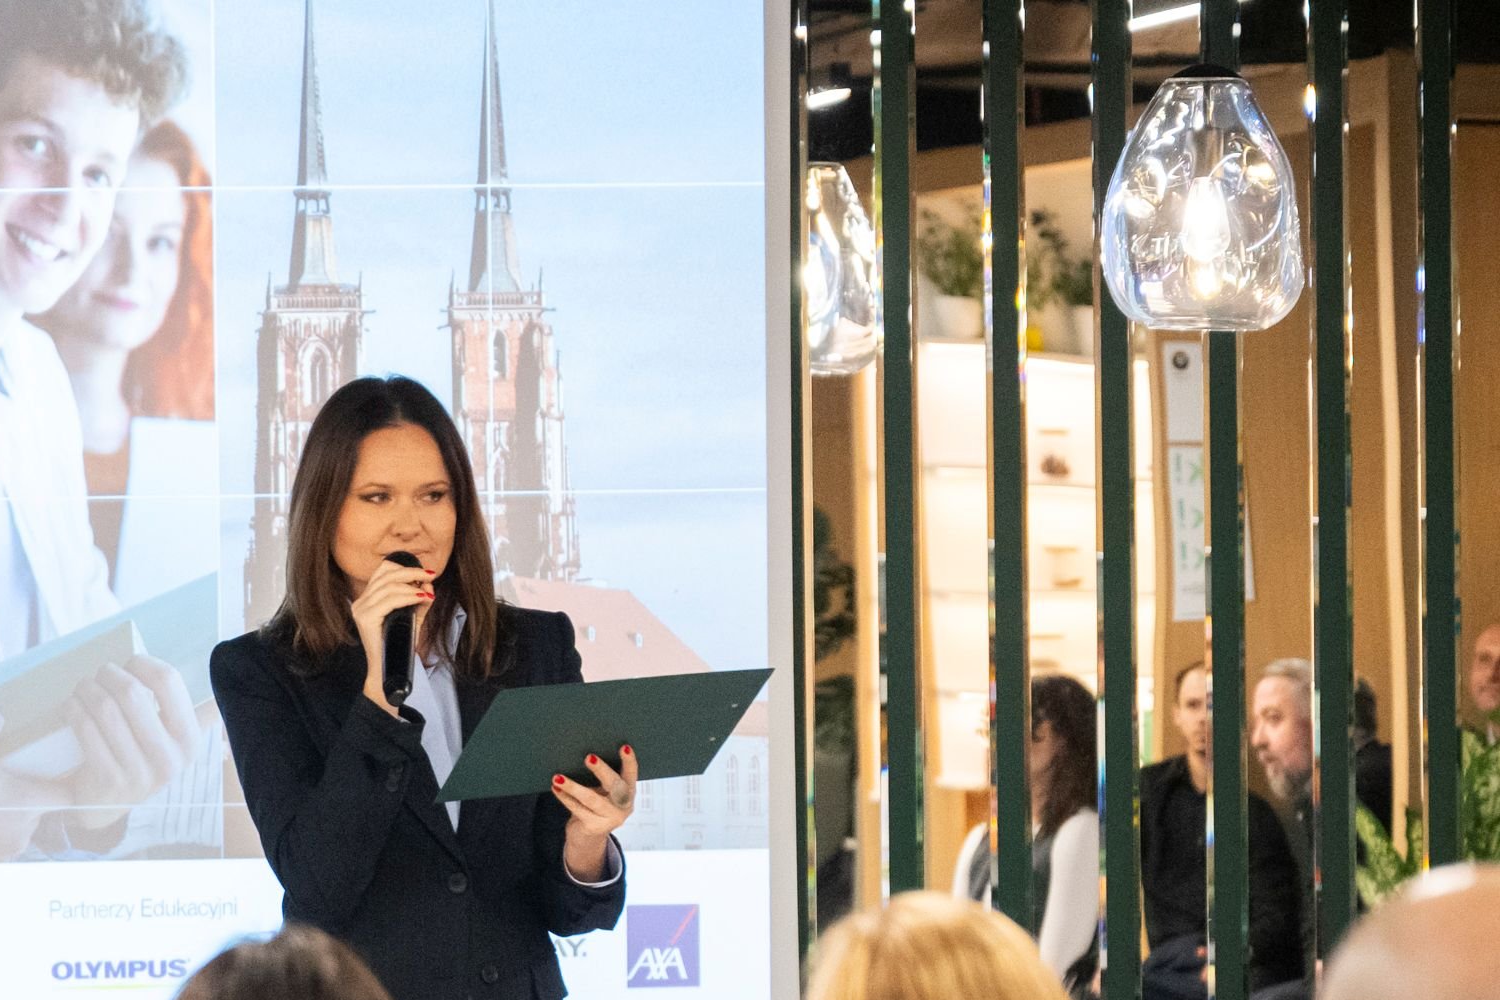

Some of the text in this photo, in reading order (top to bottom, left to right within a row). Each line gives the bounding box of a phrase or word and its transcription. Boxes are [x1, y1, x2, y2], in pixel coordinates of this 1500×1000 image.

[49, 896, 238, 921] Partnerzy Edukacyjni
[51, 958, 188, 981] OLYMPUS
[627, 947, 688, 980] AXA
